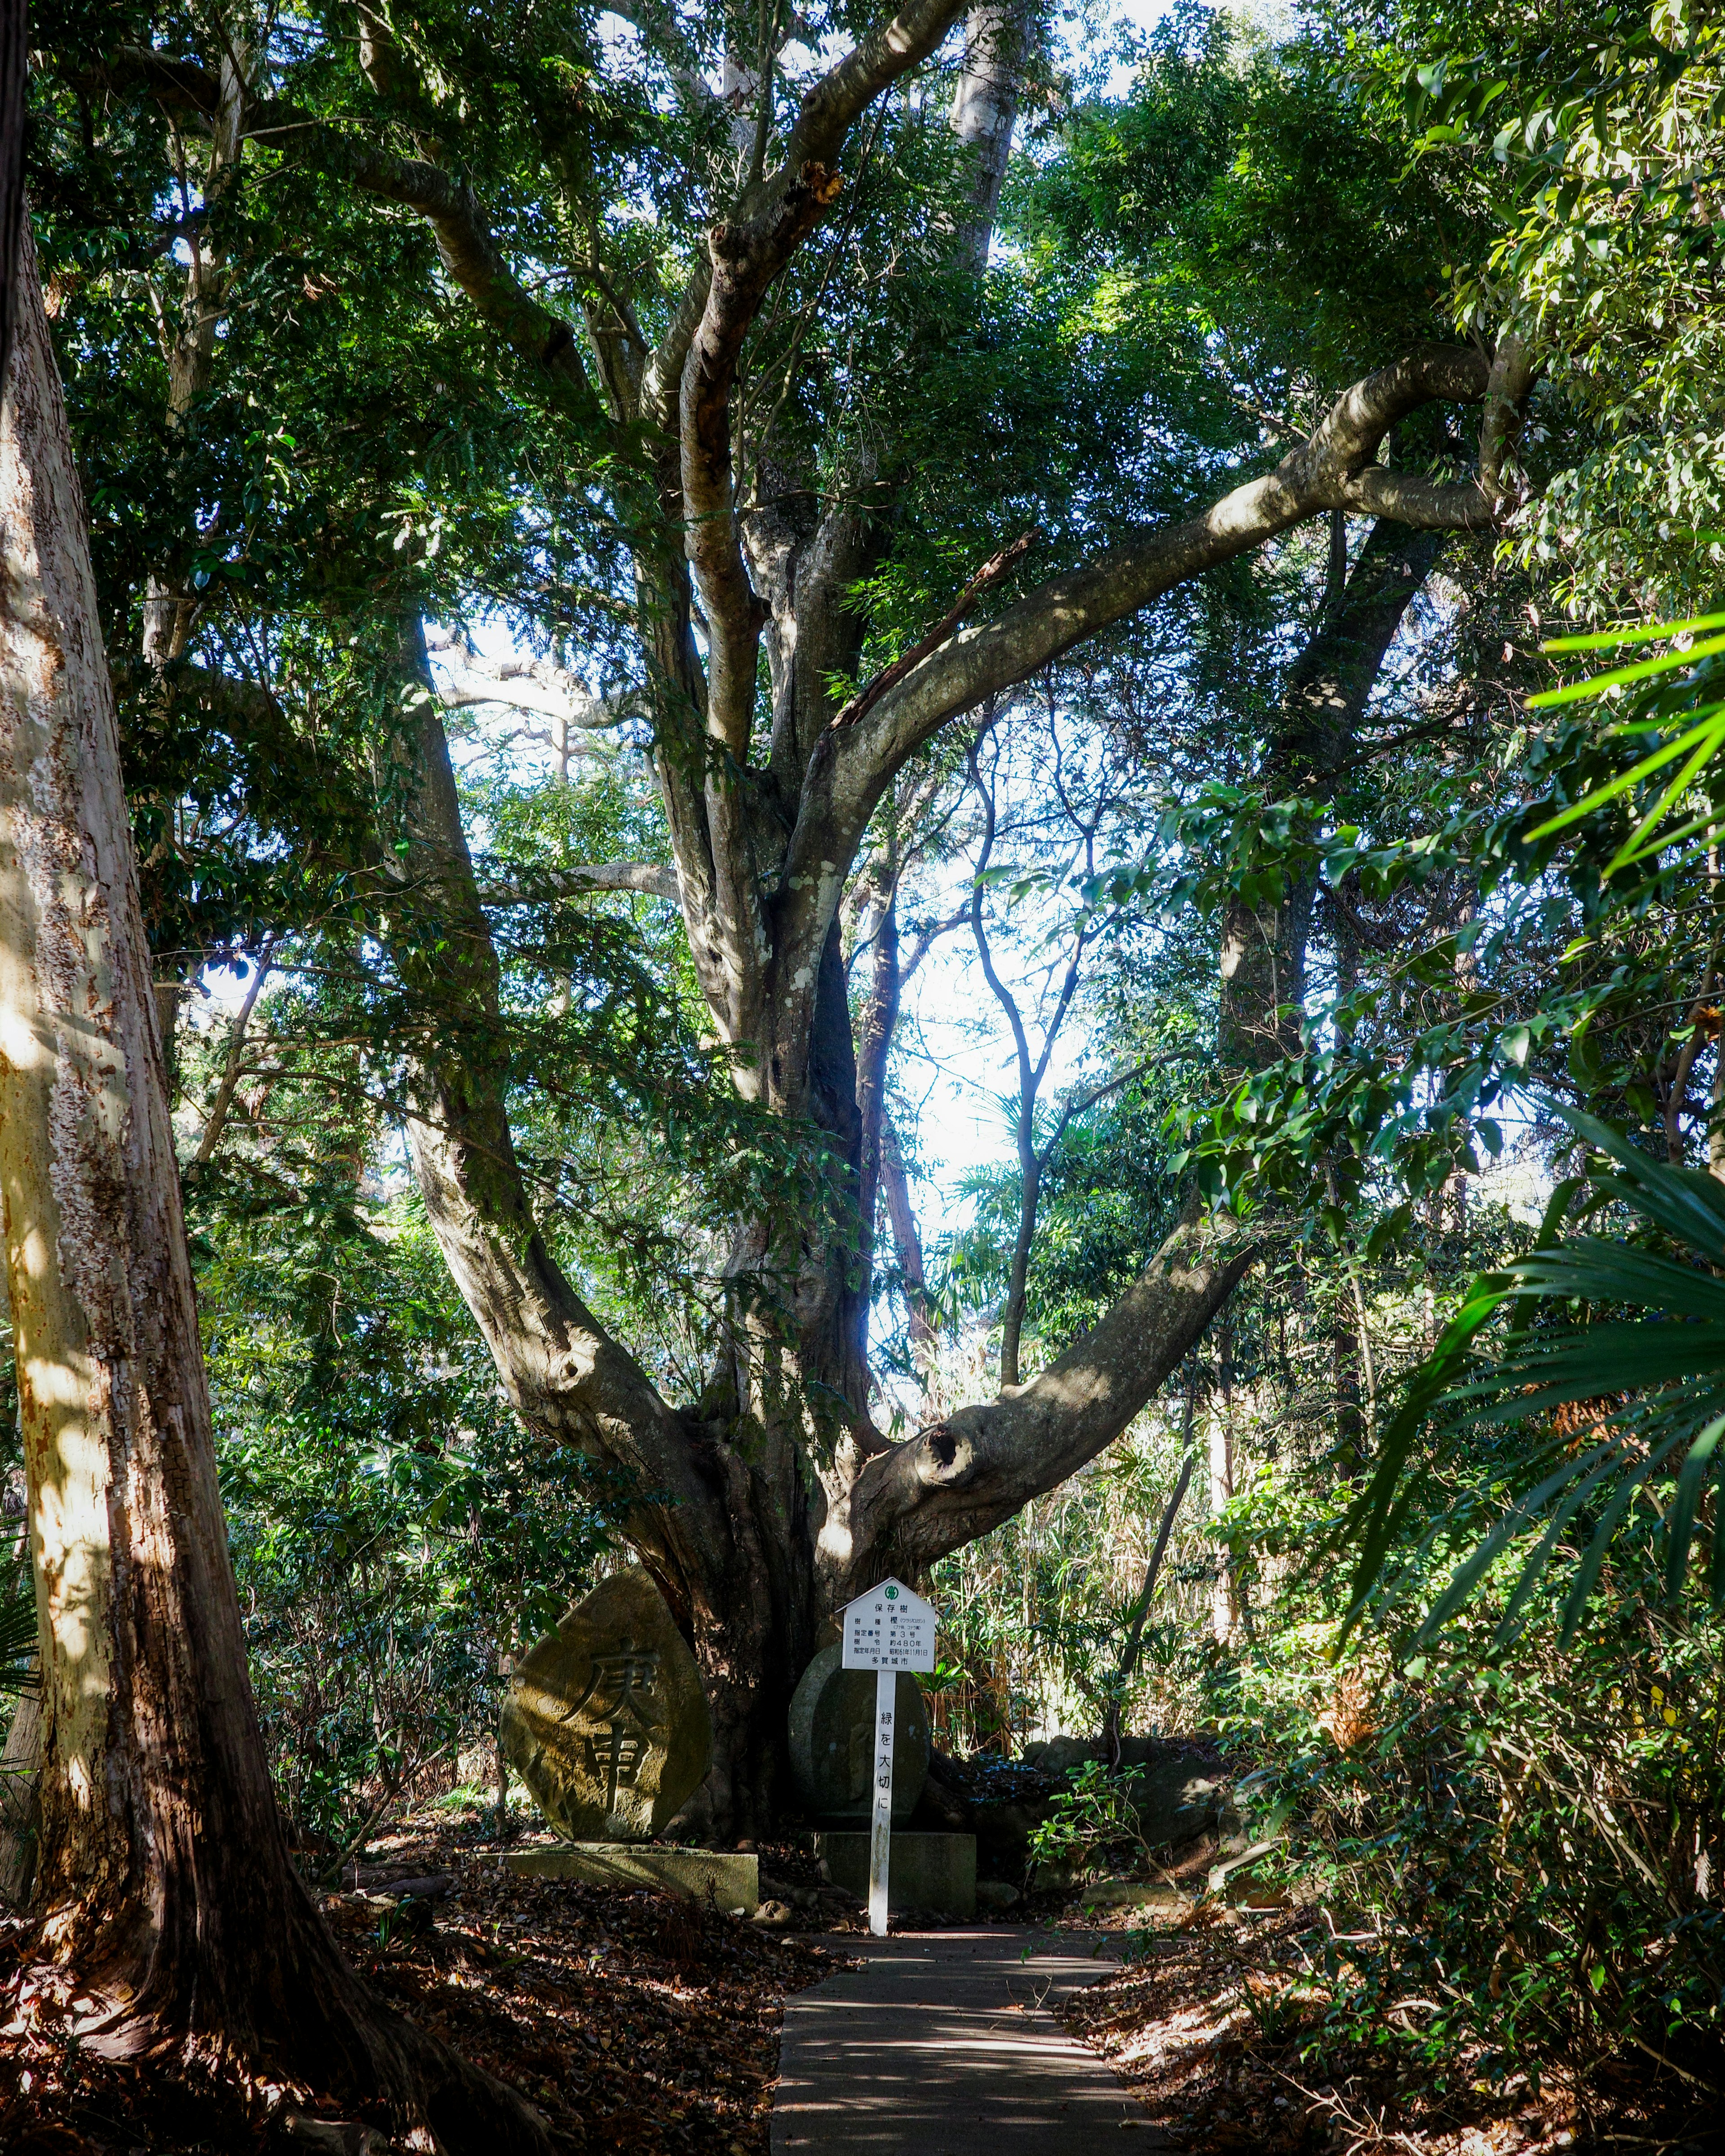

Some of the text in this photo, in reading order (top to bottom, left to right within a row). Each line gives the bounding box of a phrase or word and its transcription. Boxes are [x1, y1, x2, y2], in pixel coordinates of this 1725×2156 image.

[876, 1604, 908, 1613] 保存樹
[558, 1637, 663, 1814] 庚申
[878, 1712, 892, 1809] 緑を大切に
